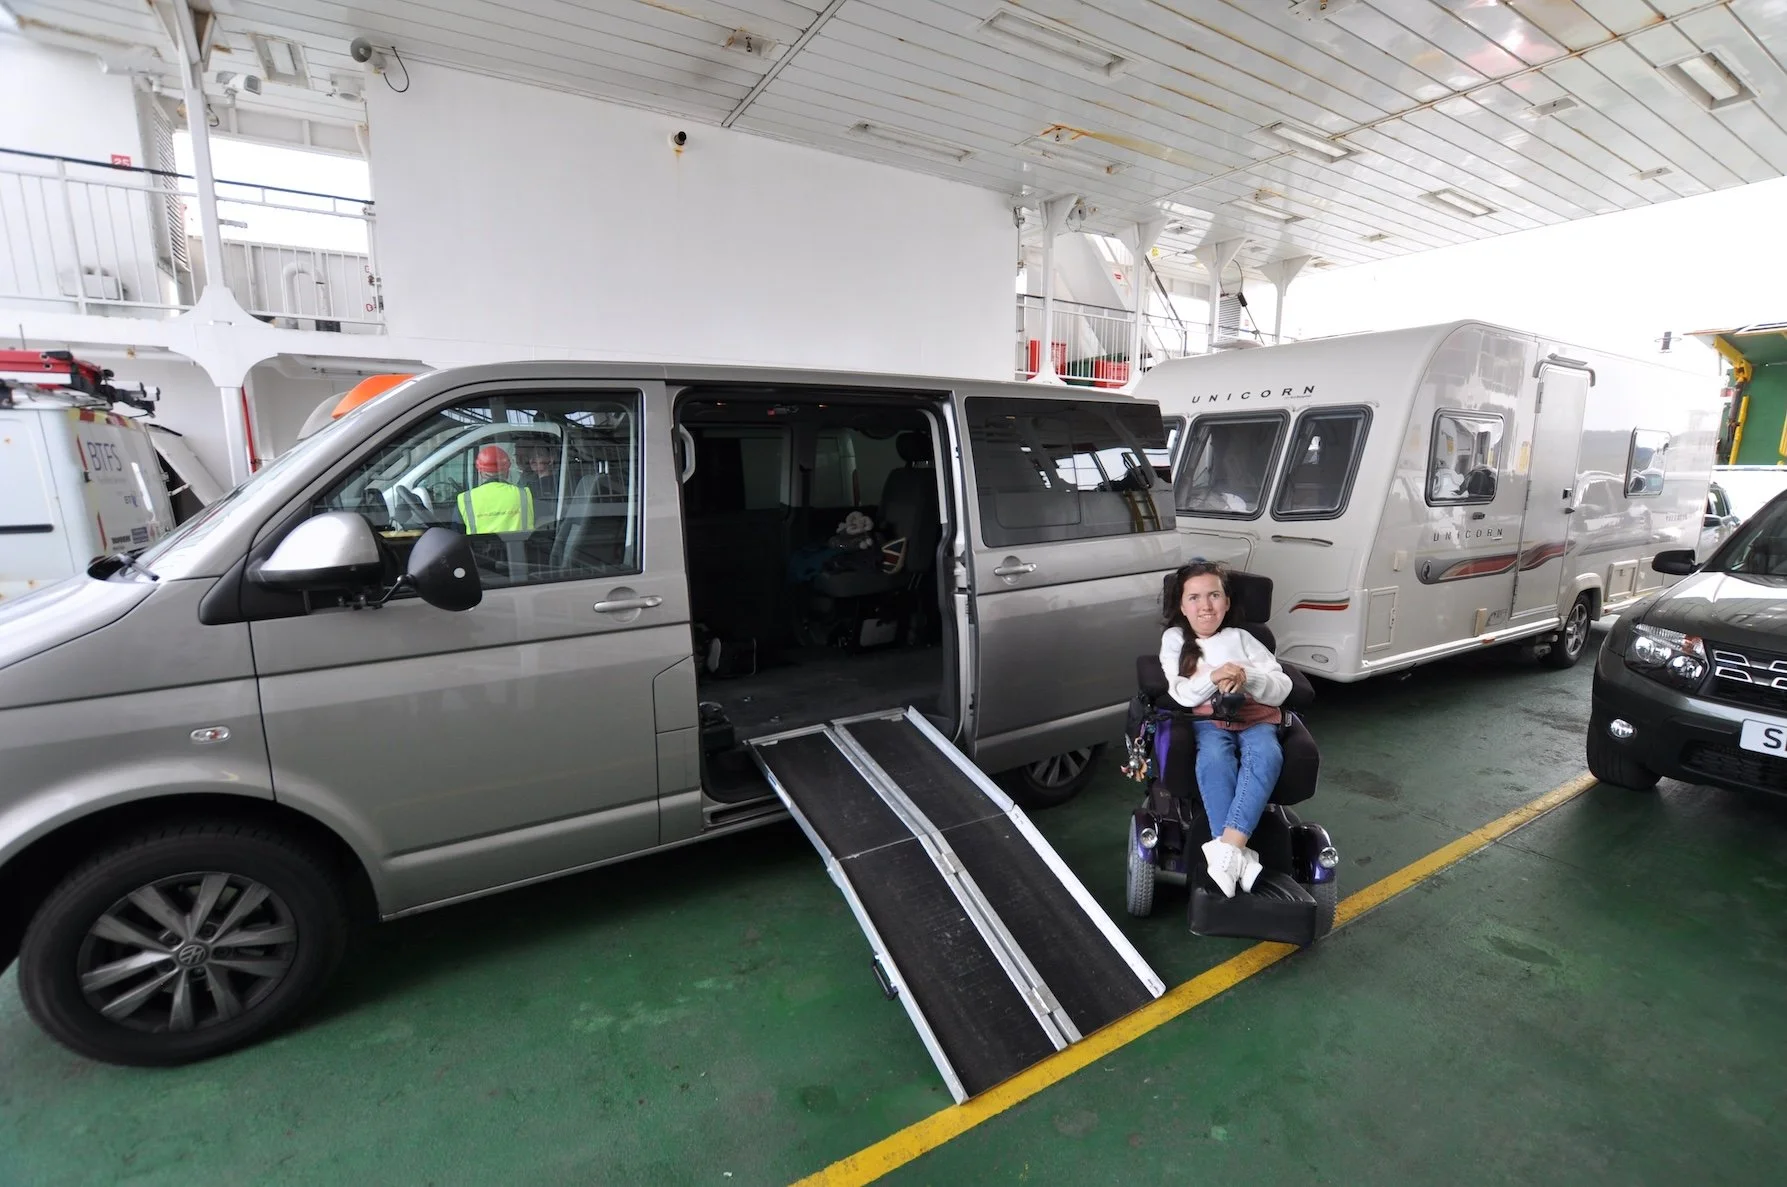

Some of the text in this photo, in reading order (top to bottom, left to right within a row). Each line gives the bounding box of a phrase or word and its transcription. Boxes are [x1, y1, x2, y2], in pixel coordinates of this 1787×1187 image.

[1192, 385, 1314, 403] UNICORN
[87, 441, 122, 471] BTFS
[1433, 528, 1503, 542] UNICORN
[1762, 727, 1787, 752] S
